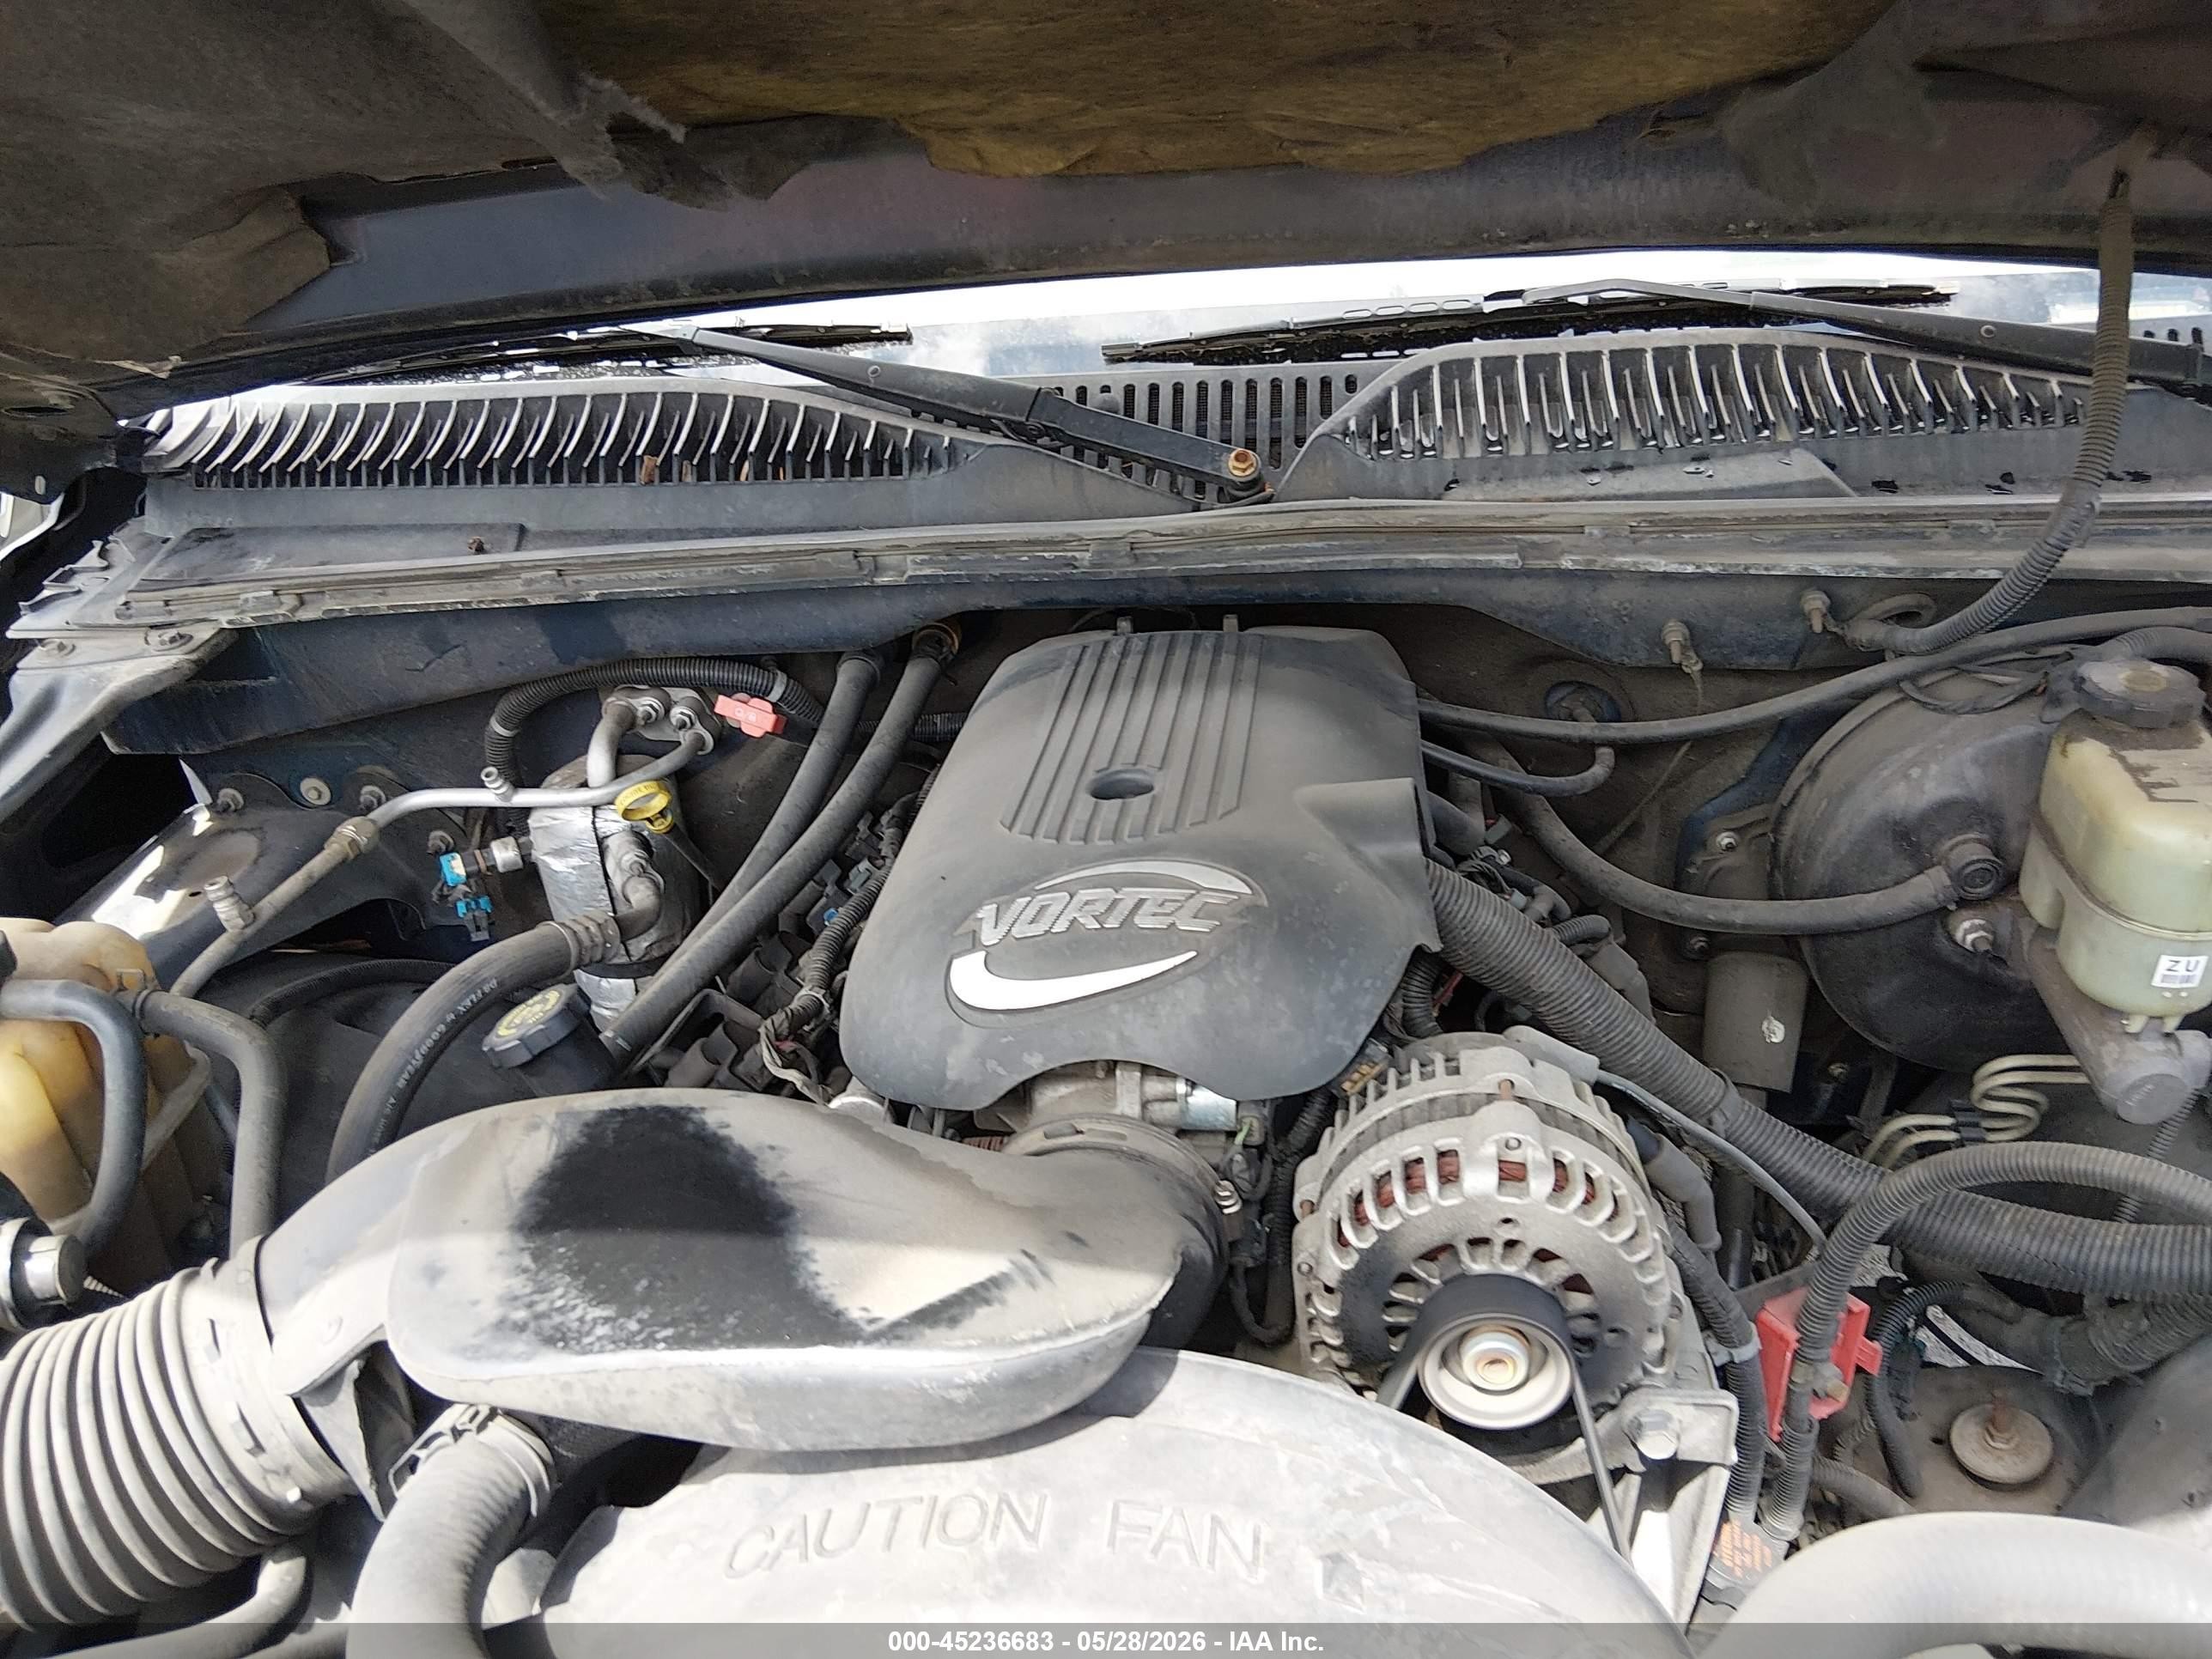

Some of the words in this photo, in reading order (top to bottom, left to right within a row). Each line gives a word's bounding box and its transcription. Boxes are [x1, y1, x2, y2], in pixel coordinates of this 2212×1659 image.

[975, 886, 1240, 946] VORTEC
[396, 1023, 447, 1089] GOODYEAR
[723, 1491, 1049, 1579] CAUTION
[1107, 1498, 1264, 1582] FAN
